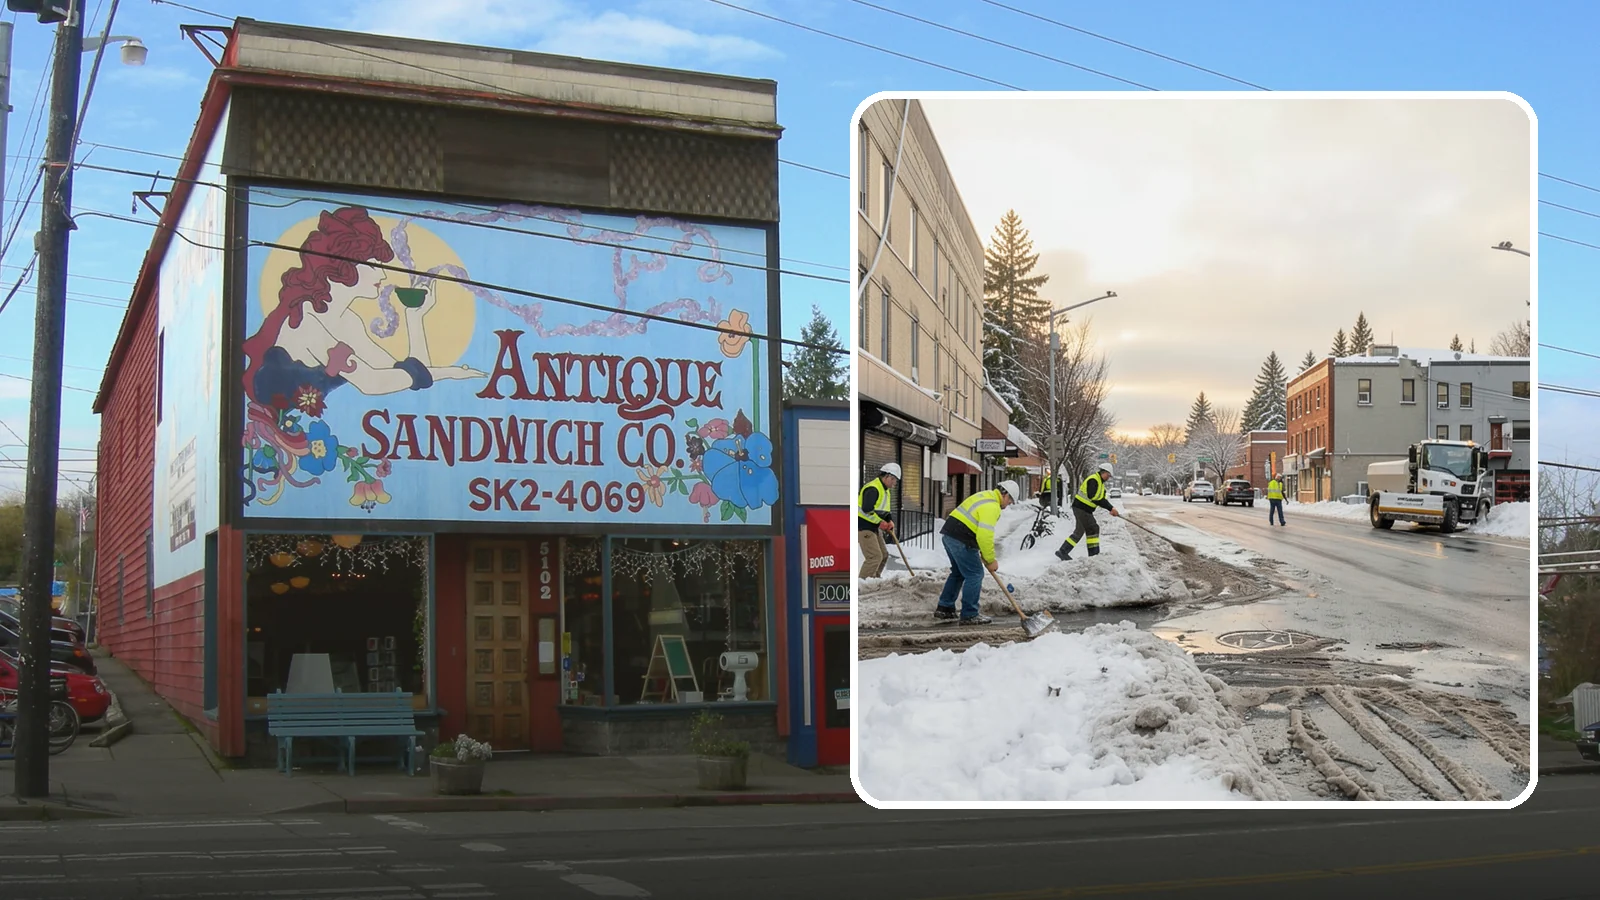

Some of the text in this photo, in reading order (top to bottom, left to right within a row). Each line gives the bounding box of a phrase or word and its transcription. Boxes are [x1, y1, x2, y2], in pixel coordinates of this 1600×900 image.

[361, 409, 685, 468] SANDWICH CO.
[469, 478, 646, 513] SK2-4069
[540, 542, 551, 599] 5102
[809, 555, 834, 569] BOOKS
